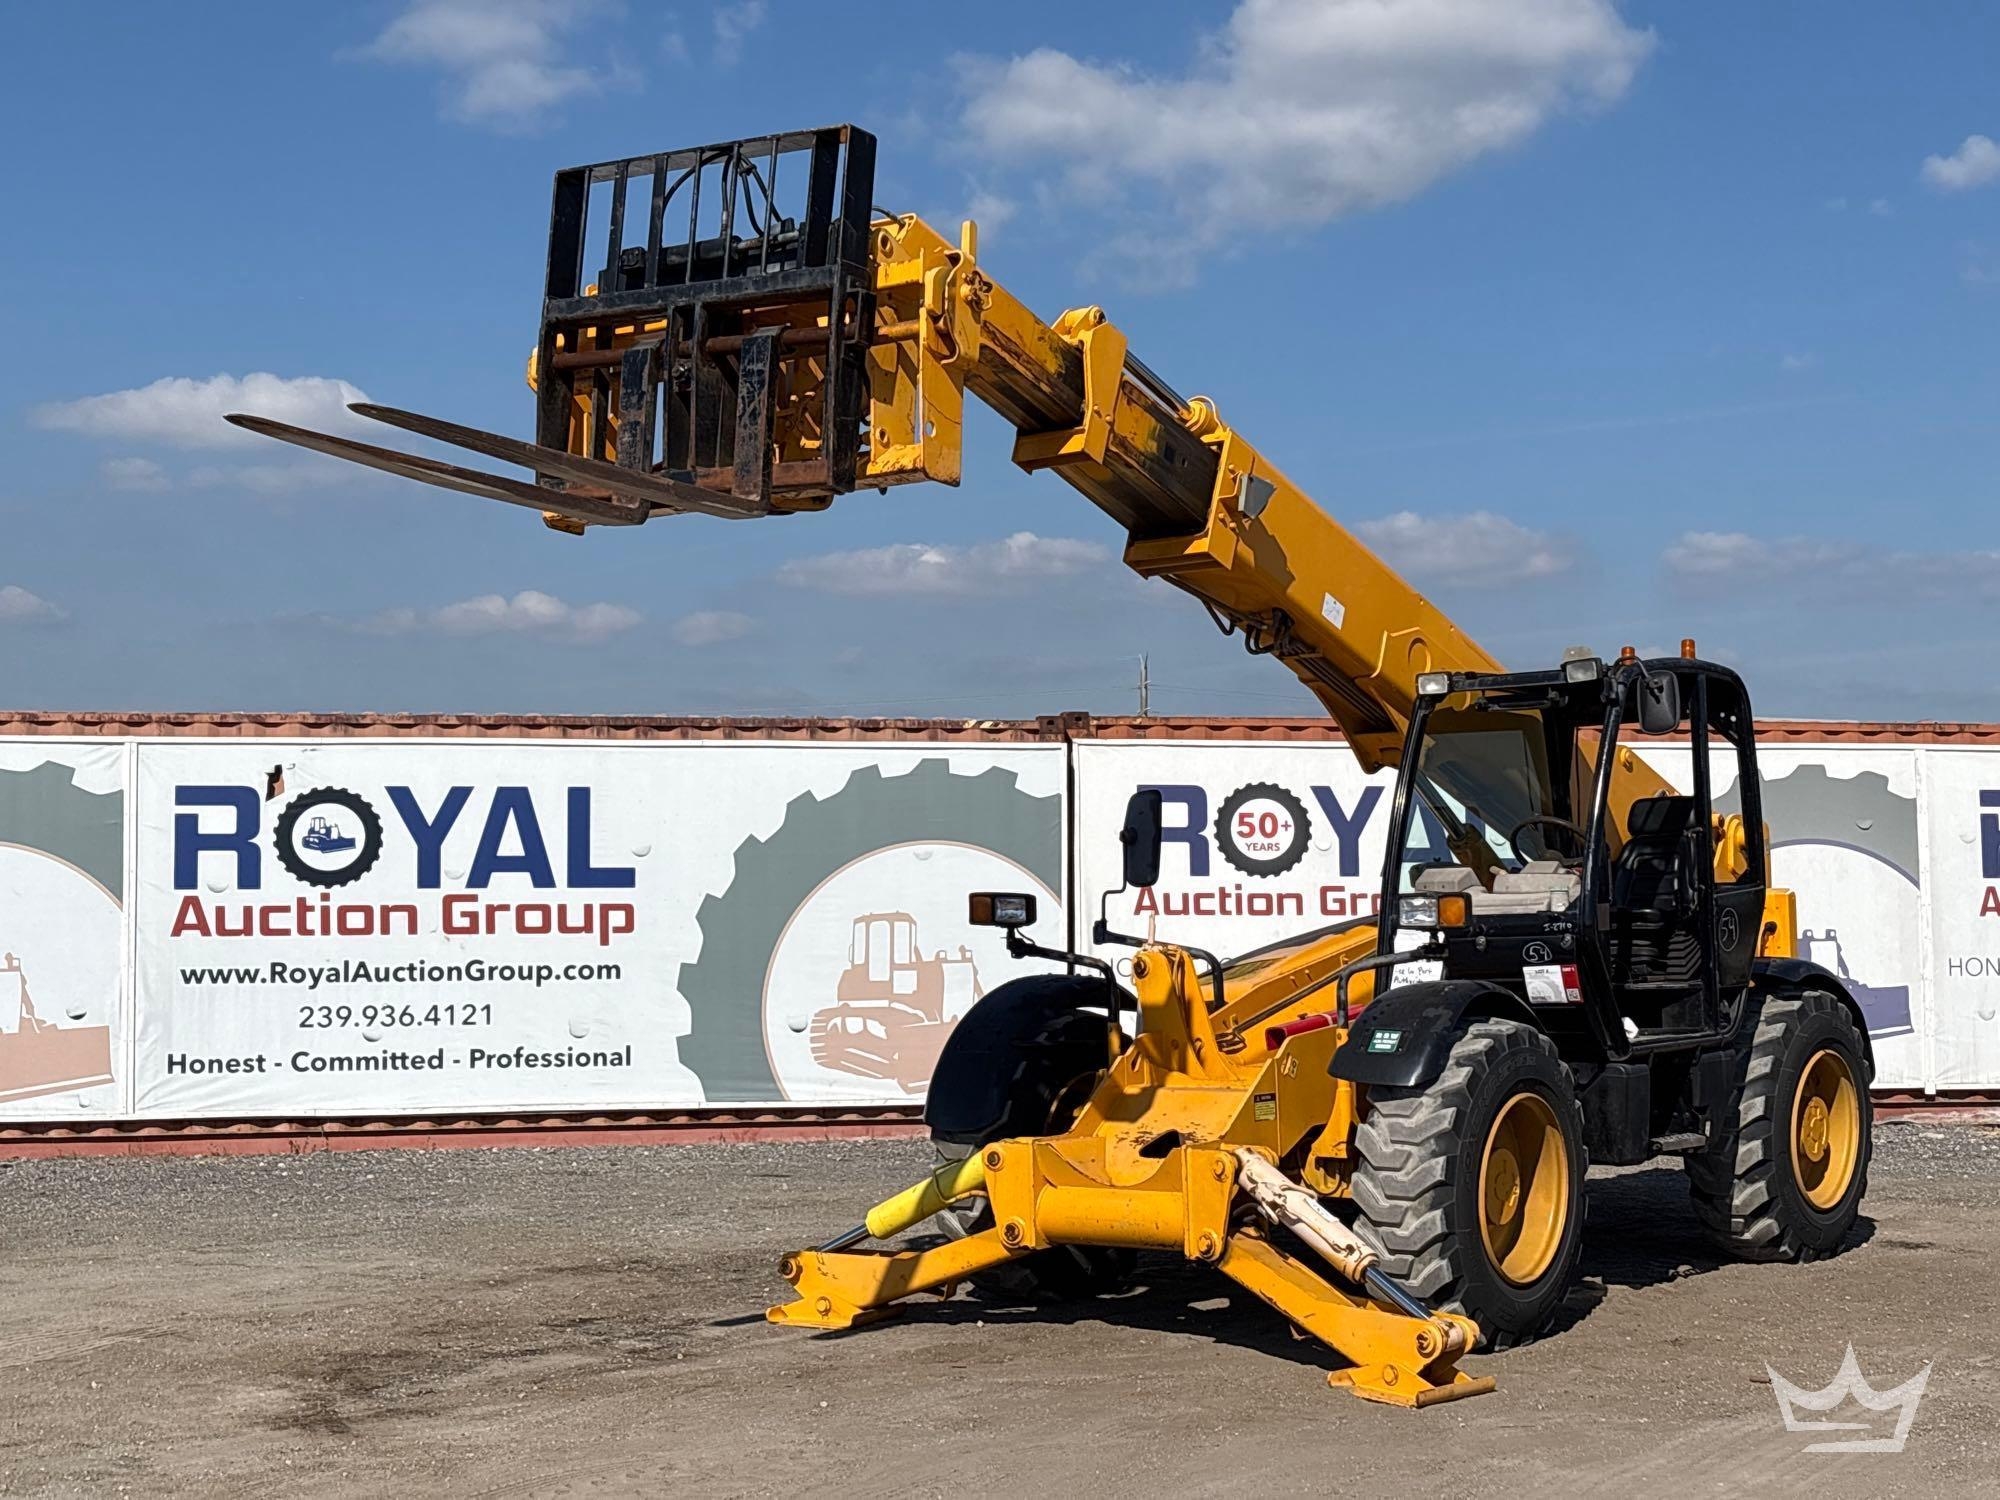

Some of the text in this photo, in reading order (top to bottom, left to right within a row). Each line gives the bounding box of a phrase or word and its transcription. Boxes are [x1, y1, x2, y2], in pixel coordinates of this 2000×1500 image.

[174, 785, 636, 889] ROYAL
[1237, 812, 1292, 838] 50+
[1245, 842, 1280, 852] YEARS
[1133, 884, 1304, 916] Auction
[170, 892, 635, 946] Auction Group
[1529, 945, 1548, 961] 54
[180, 959, 622, 990] www.RoyalAuctionGroup.com
[299, 1003, 492, 1028] 239.936.4121
[167, 1053, 267, 1075] Honest
[291, 1048, 444, 1073] Committed
[469, 1045, 631, 1069] Professional
